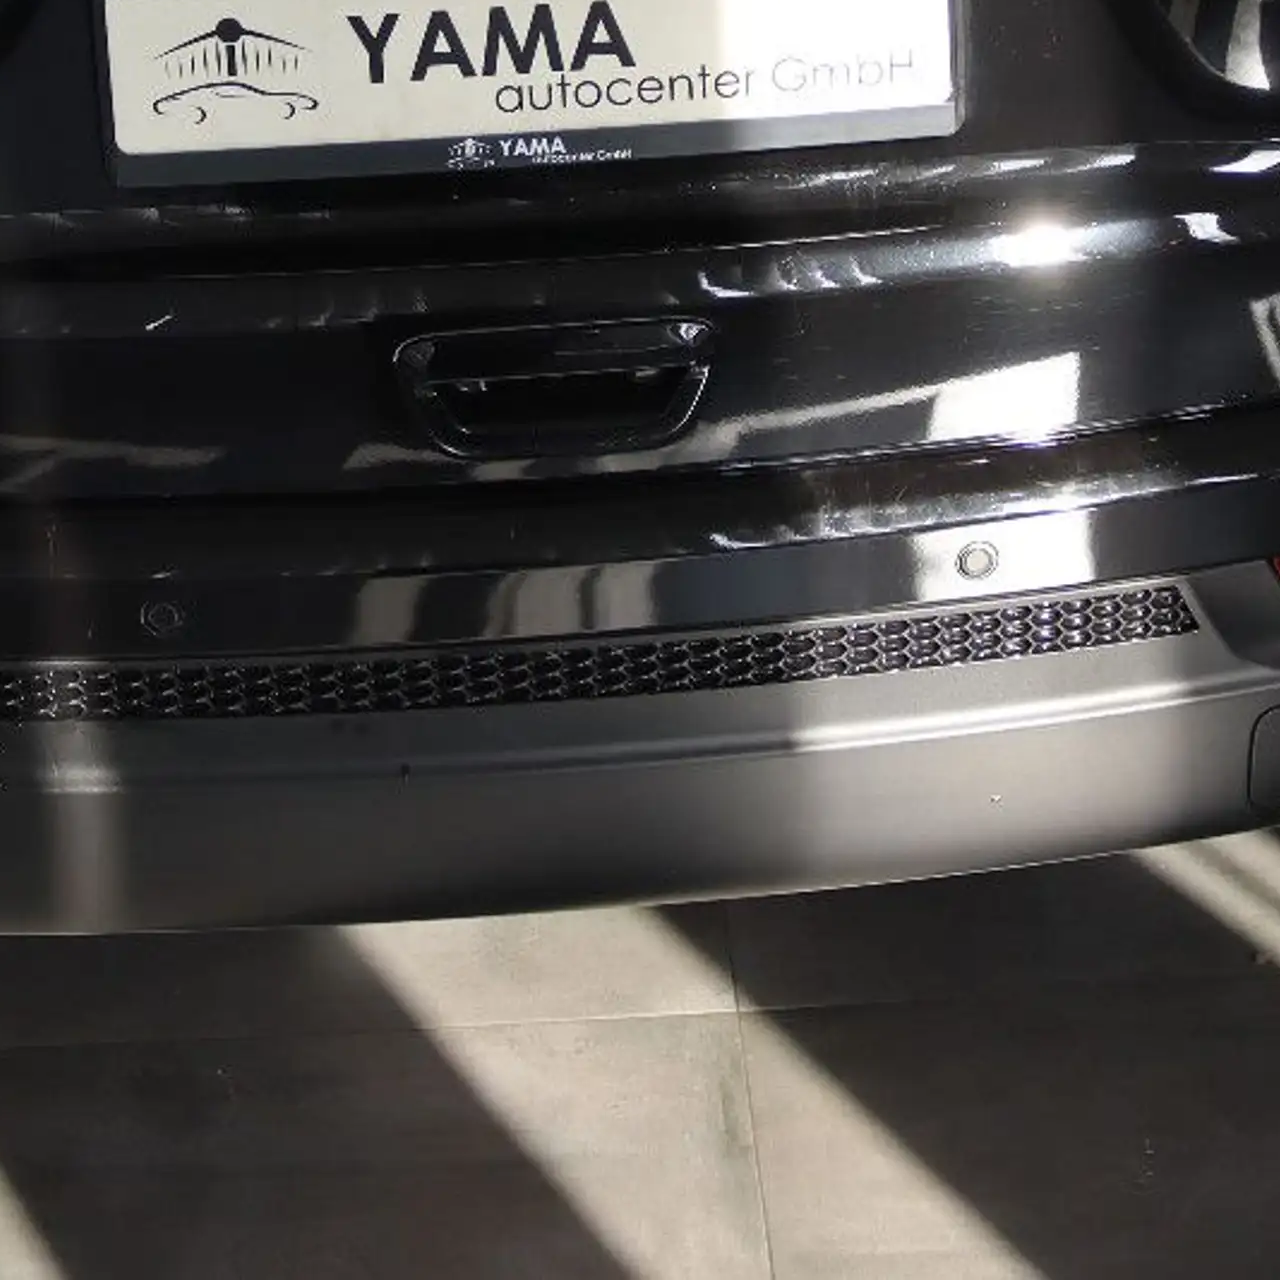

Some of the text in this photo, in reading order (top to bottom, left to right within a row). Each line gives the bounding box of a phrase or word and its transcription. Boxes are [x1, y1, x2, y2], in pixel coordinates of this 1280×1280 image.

[346, 0, 637, 84] YAMA
[495, 47, 913, 113] autocenter GmbH
[500, 135, 567, 157] YAMA
